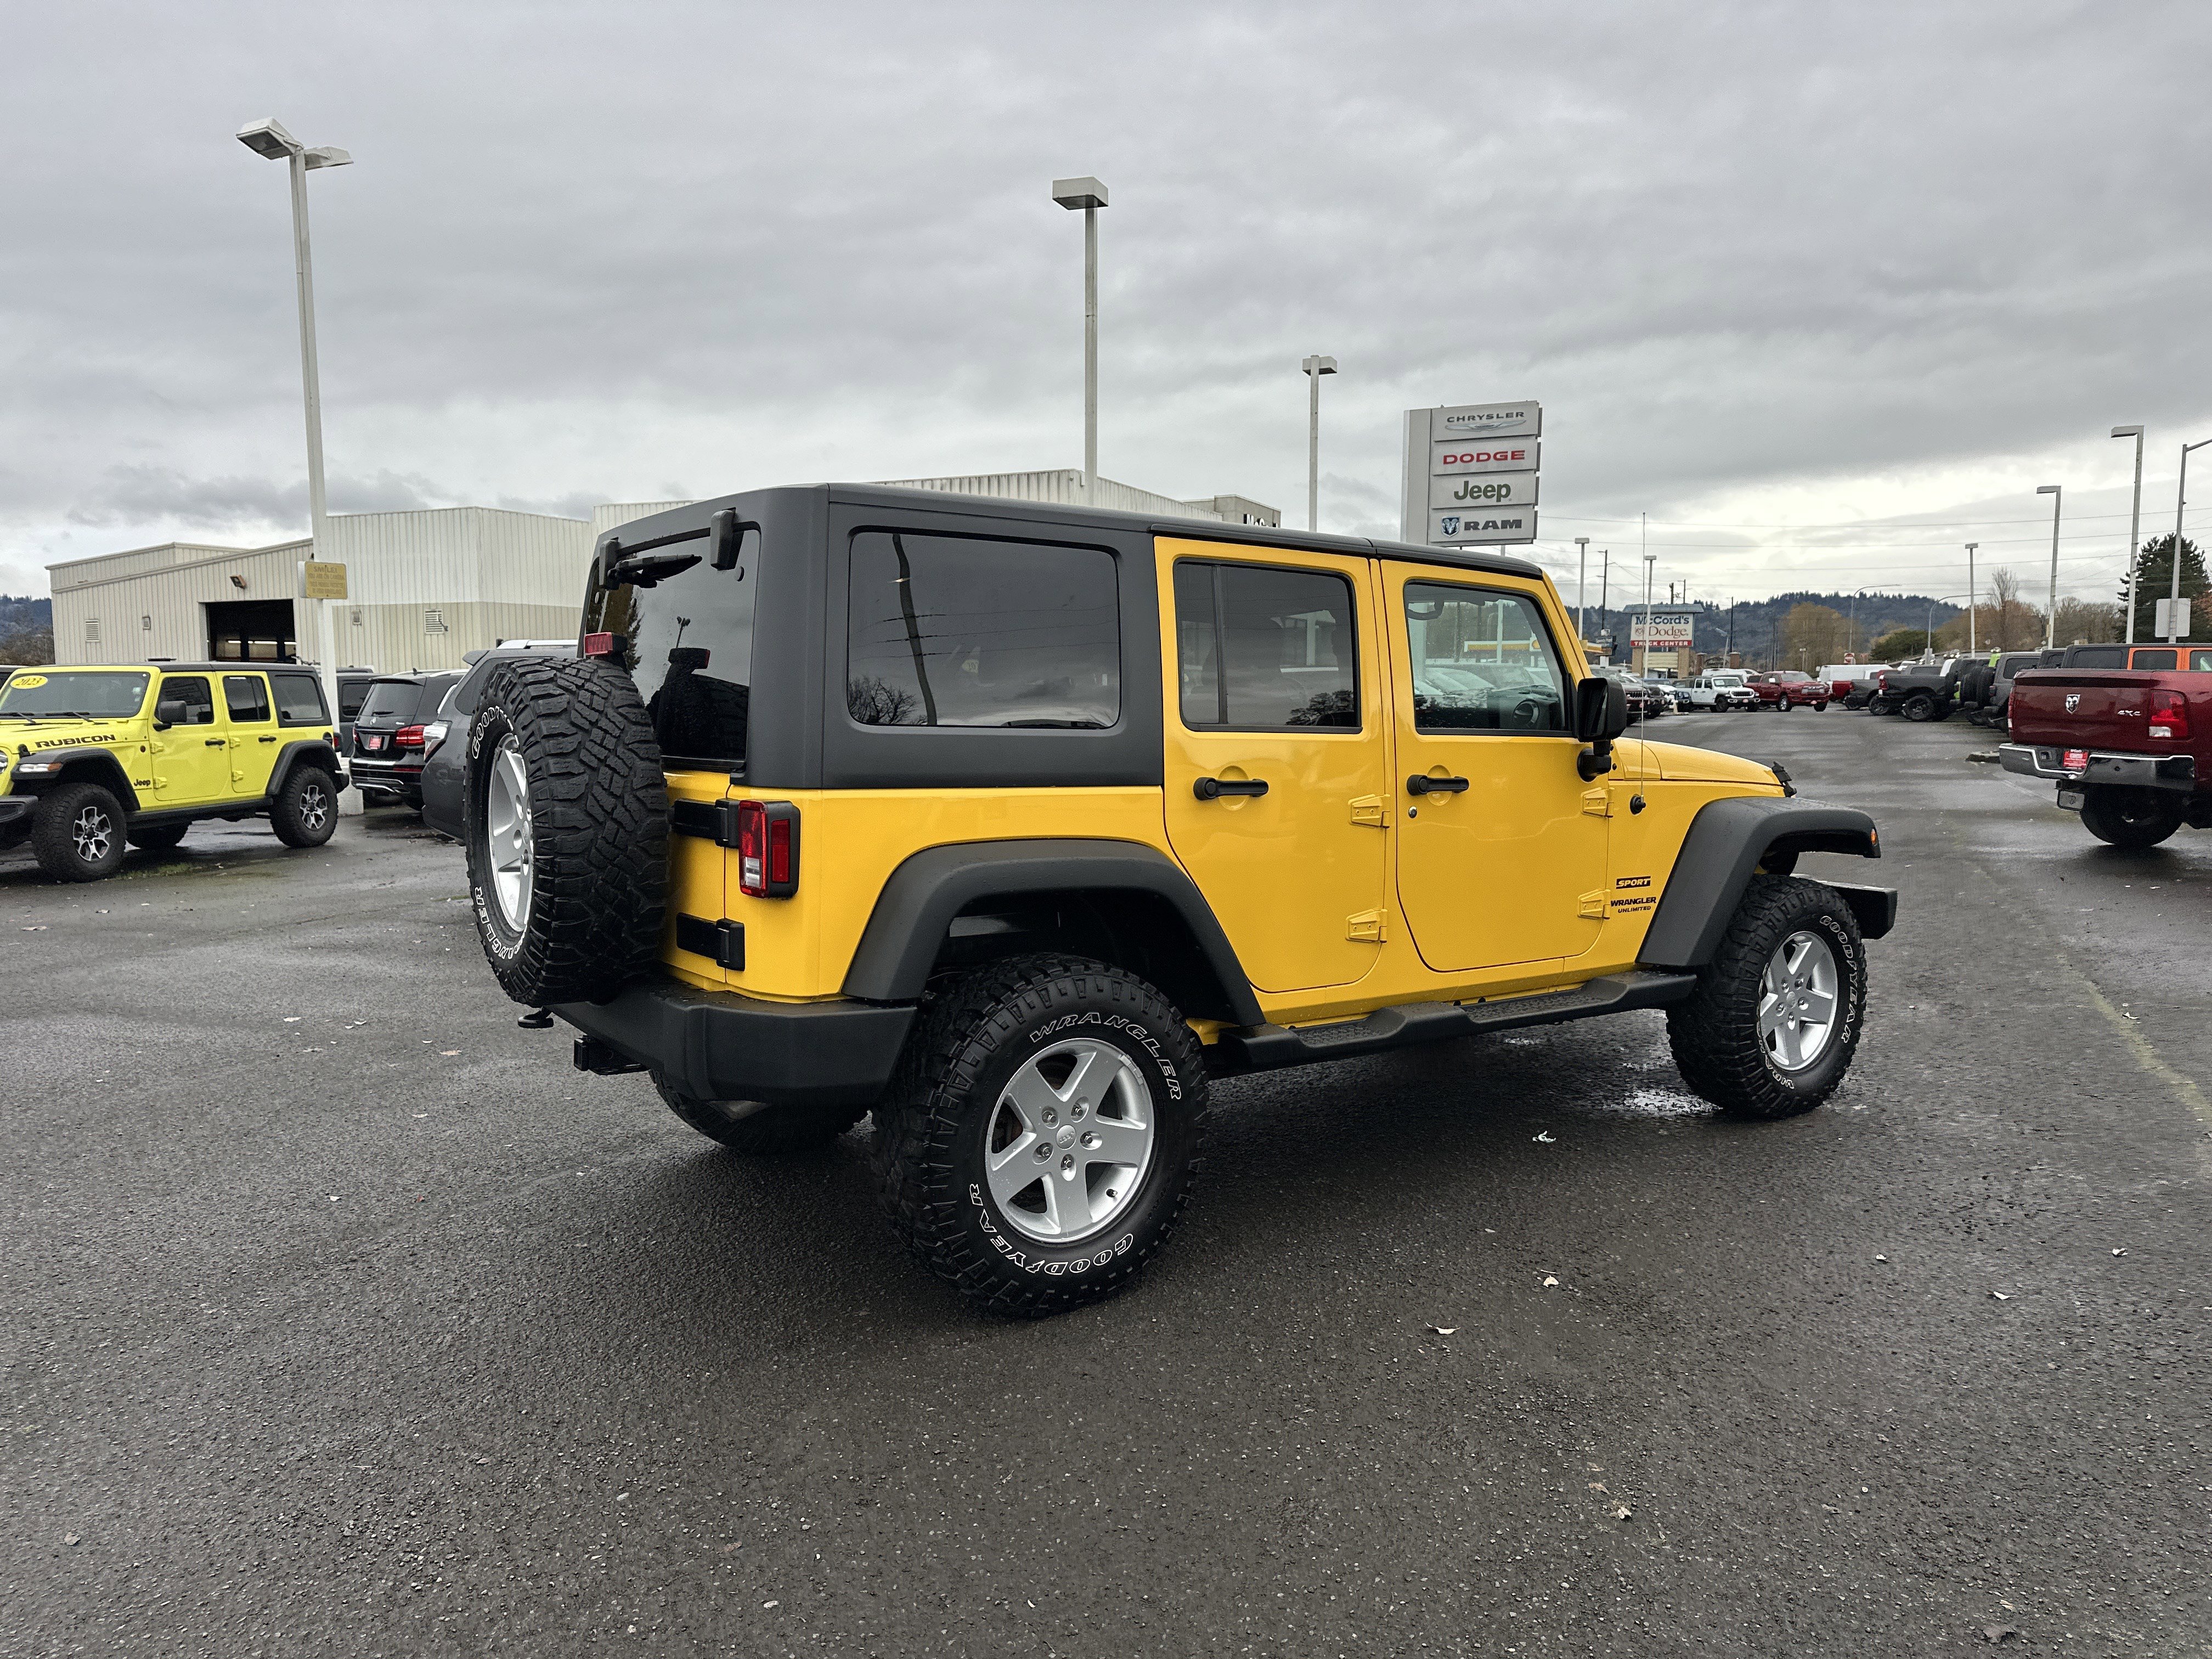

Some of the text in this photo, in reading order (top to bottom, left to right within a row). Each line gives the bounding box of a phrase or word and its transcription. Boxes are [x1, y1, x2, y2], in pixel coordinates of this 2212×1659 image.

[1447, 411, 1524, 423] CHRYSLER
[1443, 450, 1525, 465] DODGE
[1453, 481, 1511, 502] Jeep
[1464, 519, 1522, 531] RAM
[35, 734, 116, 748] RUBICON
[133, 778, 151, 787] Jeep
[1618, 878, 1650, 887] SPORT
[1610, 896, 1656, 907] WRANGLER
[1820, 916, 1858, 1043] GOODYEAR
[1029, 1012, 1182, 1100] WRANGLER
[969, 1183, 1133, 1276] GOODYEAR
